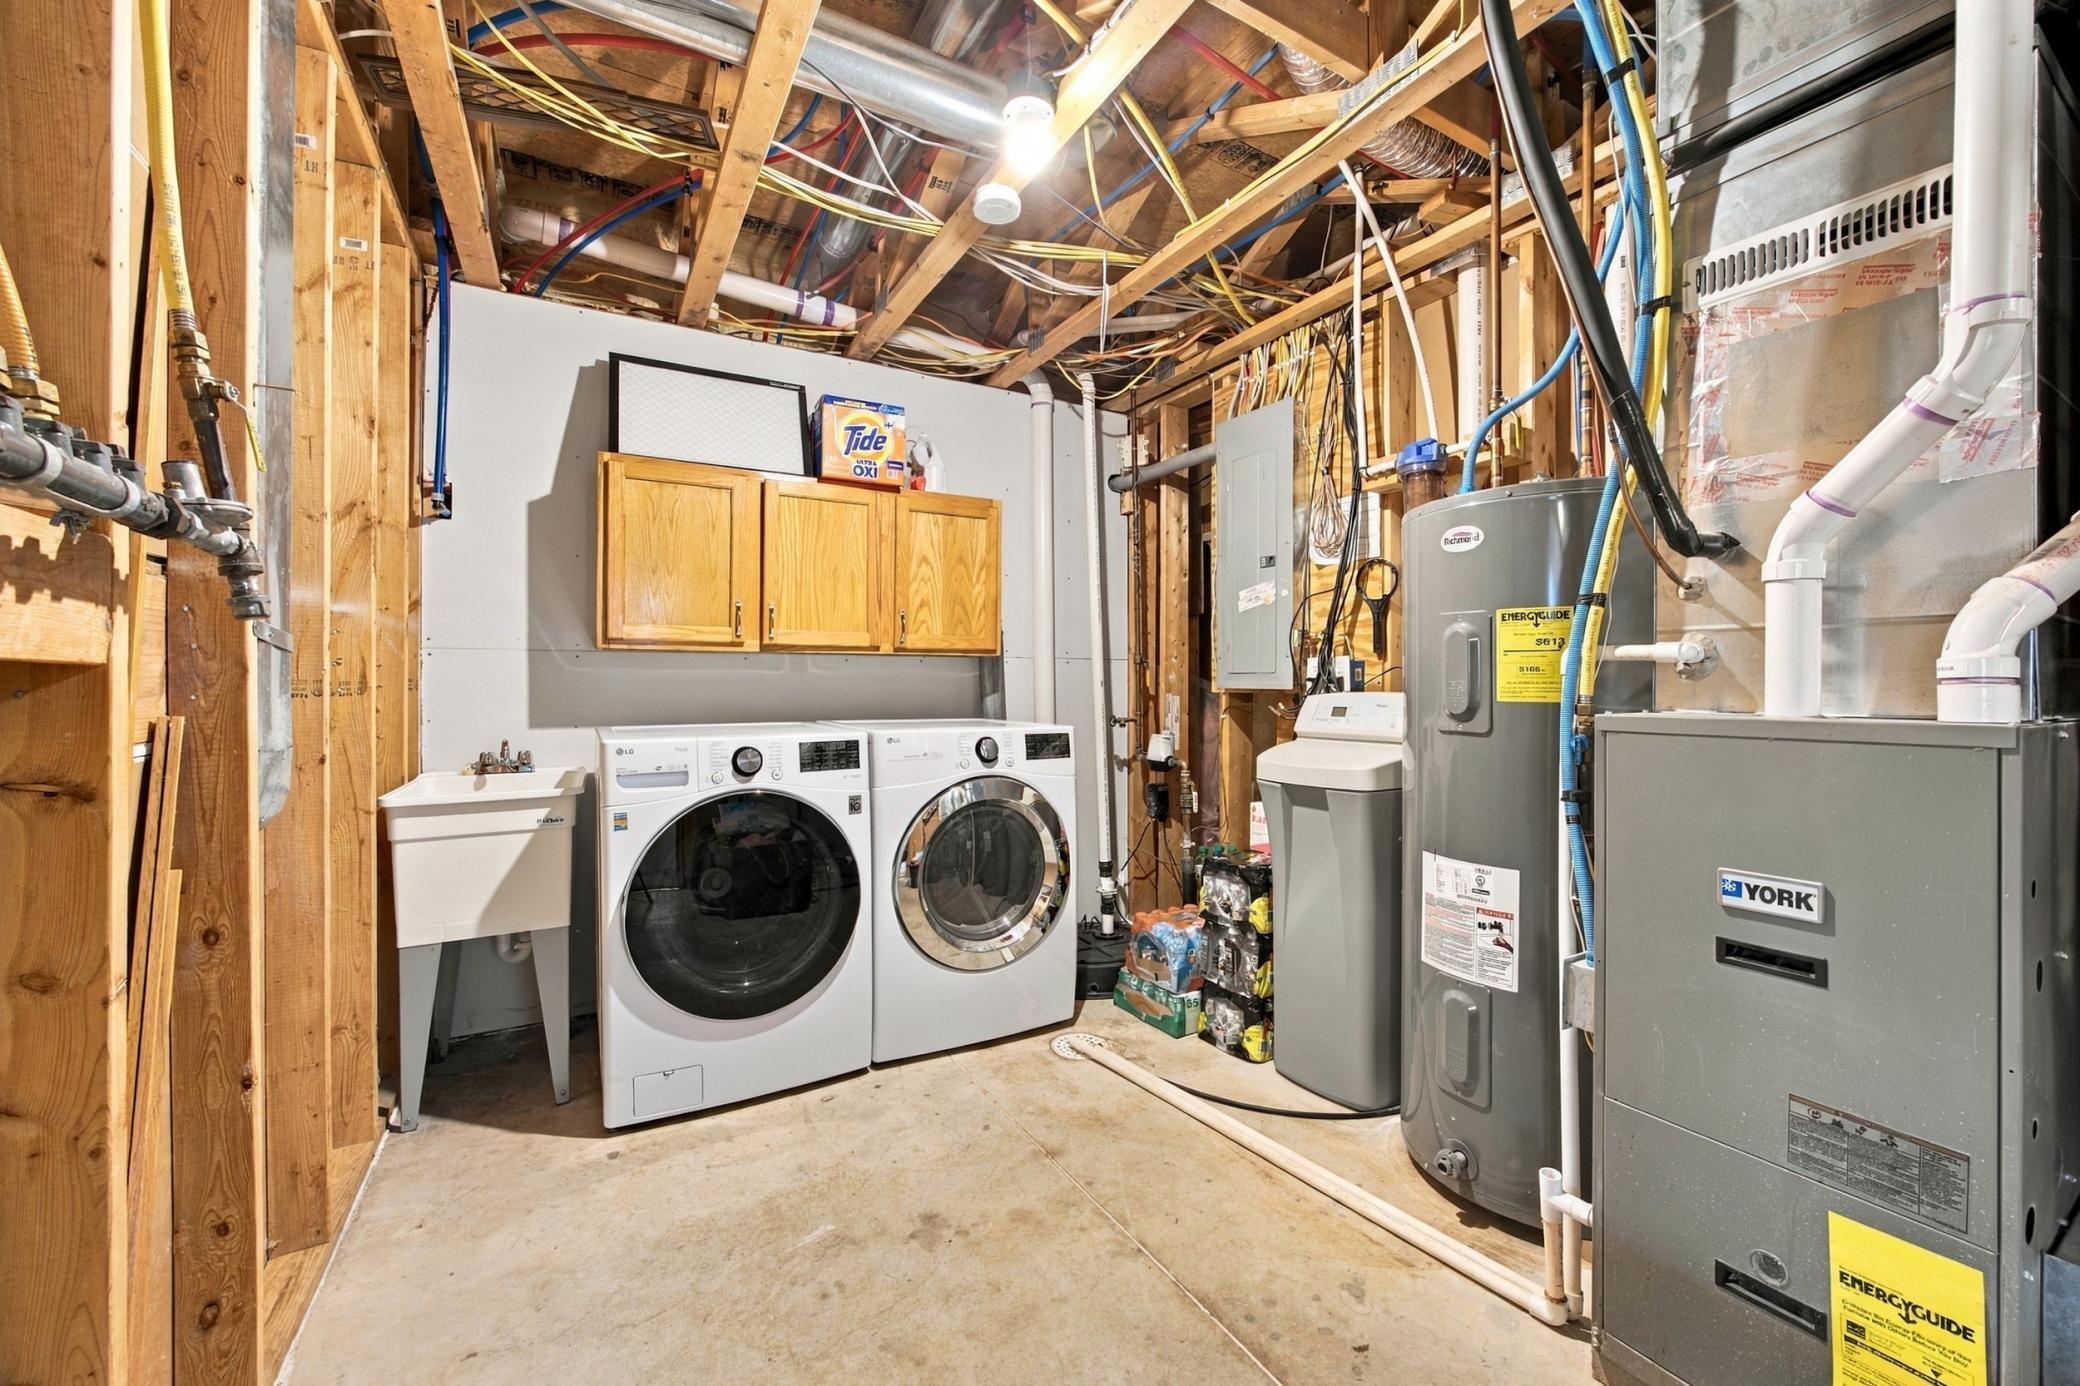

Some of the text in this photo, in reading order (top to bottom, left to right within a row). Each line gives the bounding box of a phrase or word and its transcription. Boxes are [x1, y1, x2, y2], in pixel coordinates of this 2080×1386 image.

[844, 425, 888, 456] Tide
[853, 465, 878, 478] OXI
[856, 459, 877, 467] ULTRA
[1501, 610, 1570, 624] ENERGYGUIDE
[1744, 882, 1815, 912] YORK
[1839, 1270, 1976, 1344] ENERGYGUIDE
